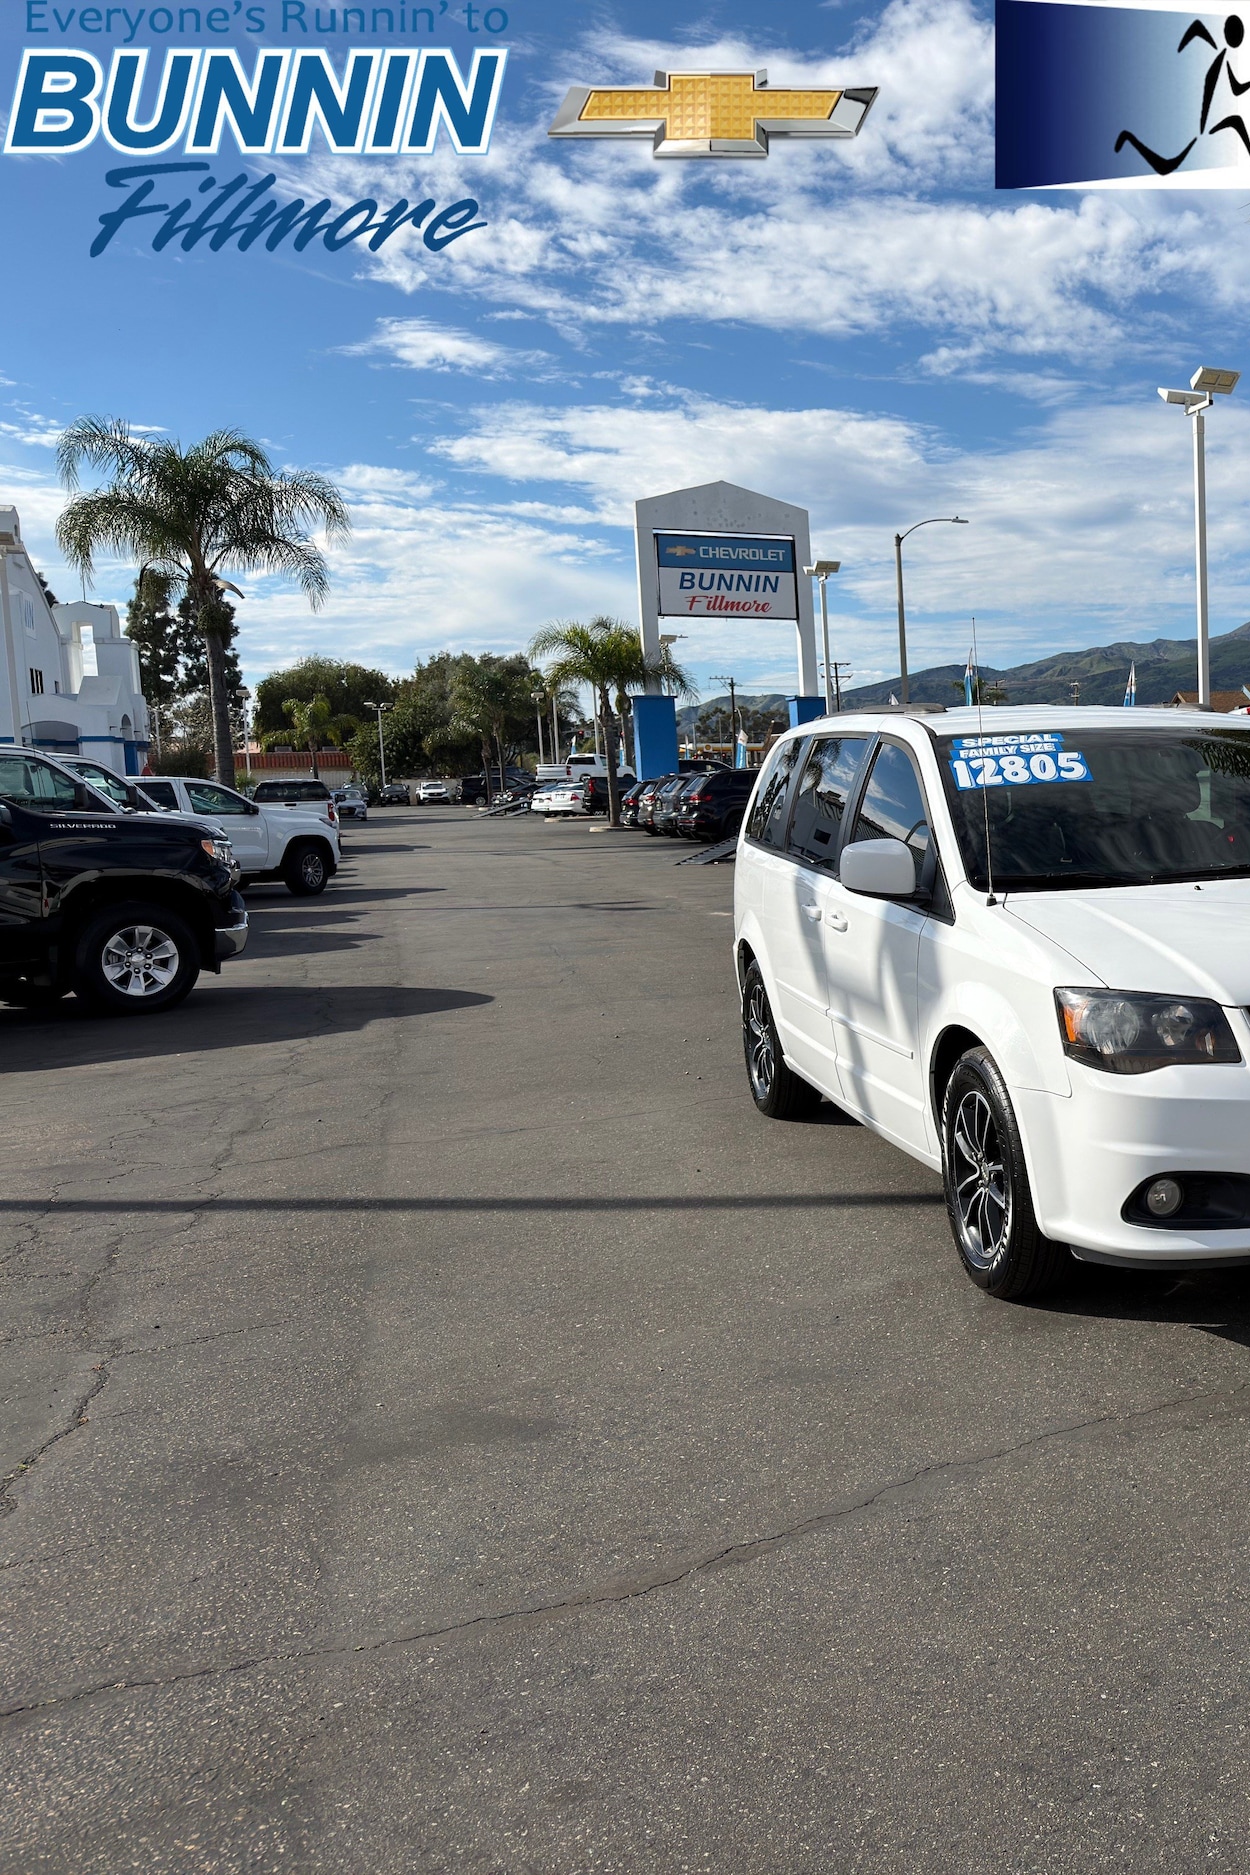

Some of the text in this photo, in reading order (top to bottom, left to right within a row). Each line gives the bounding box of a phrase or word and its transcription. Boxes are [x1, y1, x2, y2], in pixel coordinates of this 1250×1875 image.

[699, 546, 785, 561] CHEVROLET
[679, 572, 779, 592] BUNNIN
[685, 595, 771, 612] Fillmore
[961, 734, 1058, 747] SPECIAL
[959, 743, 1056, 758] FAMILY SIZE
[953, 752, 1086, 787] 12805
